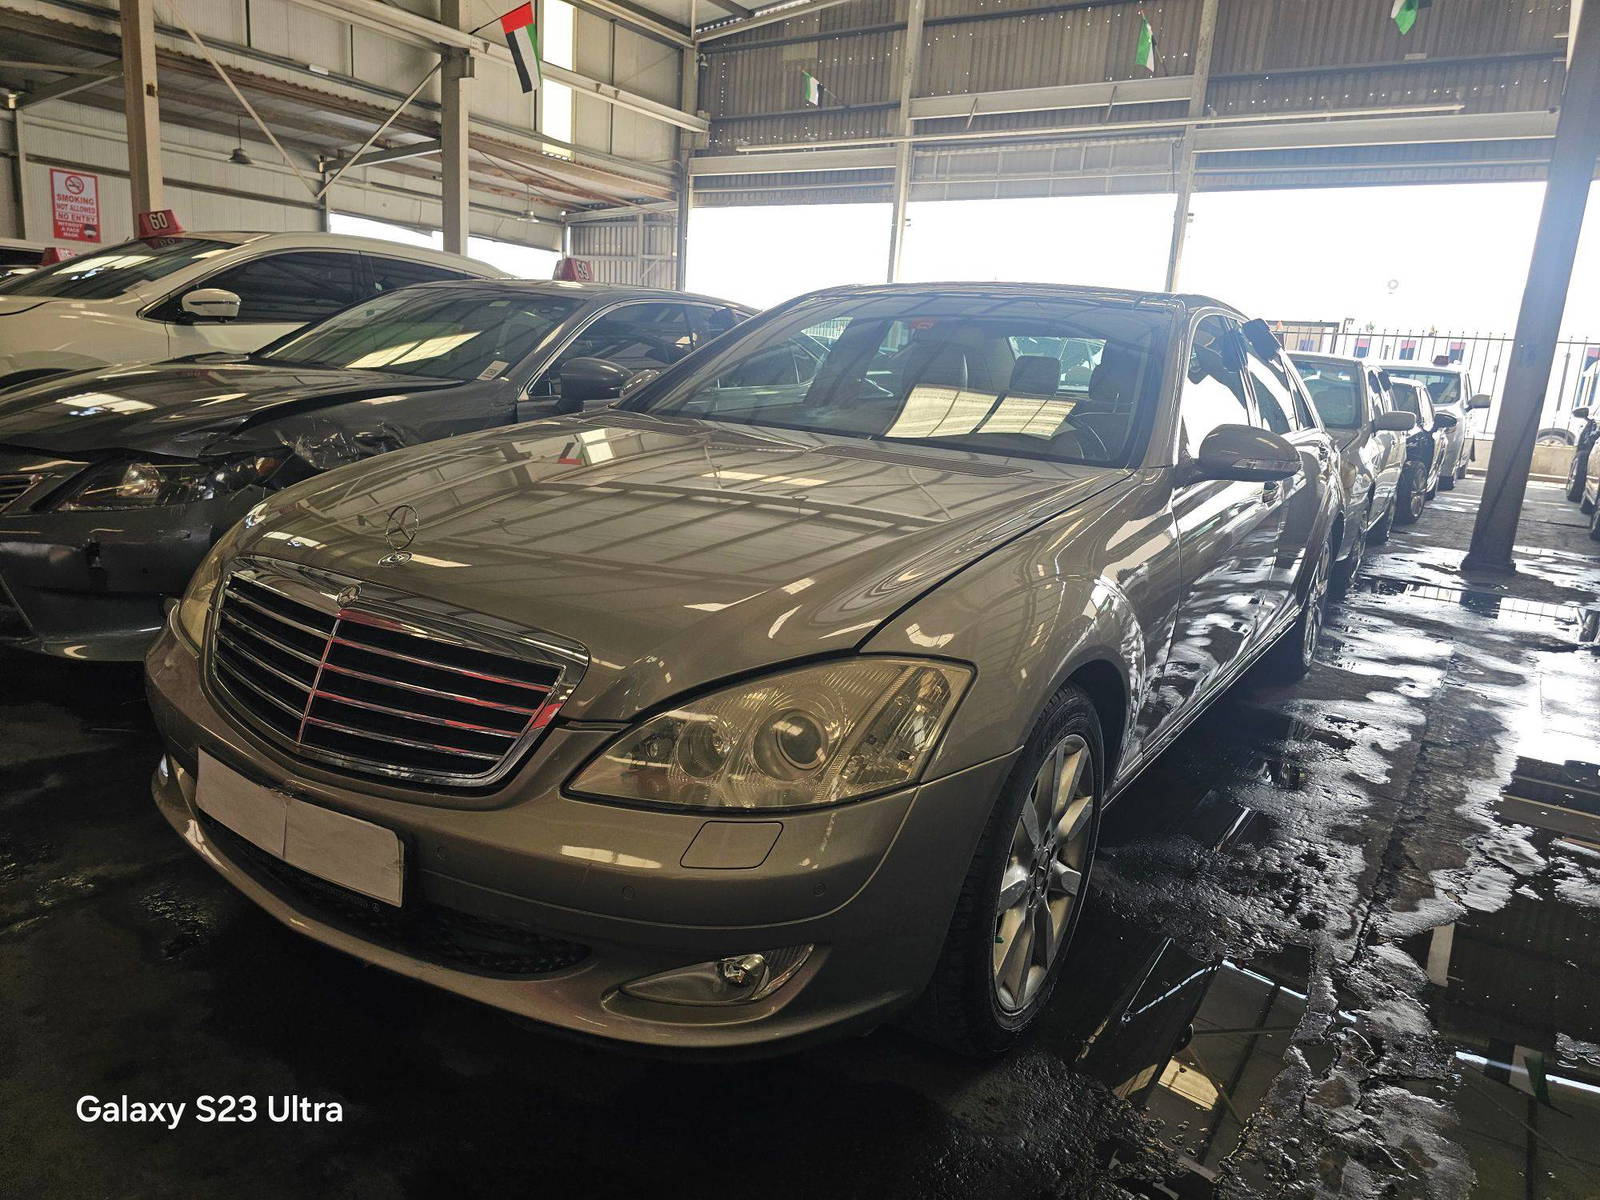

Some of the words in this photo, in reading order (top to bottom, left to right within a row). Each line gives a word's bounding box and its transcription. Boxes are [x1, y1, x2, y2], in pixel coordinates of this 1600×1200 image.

[56, 193, 95, 206] SMOKING
[56, 203, 68, 211] NOT
[70, 205, 96, 214] ALLOWED
[58, 211, 69, 220] NO
[71, 213, 96, 223] ENTRY
[149, 212, 168, 230] 60
[576, 260, 590, 281] 59
